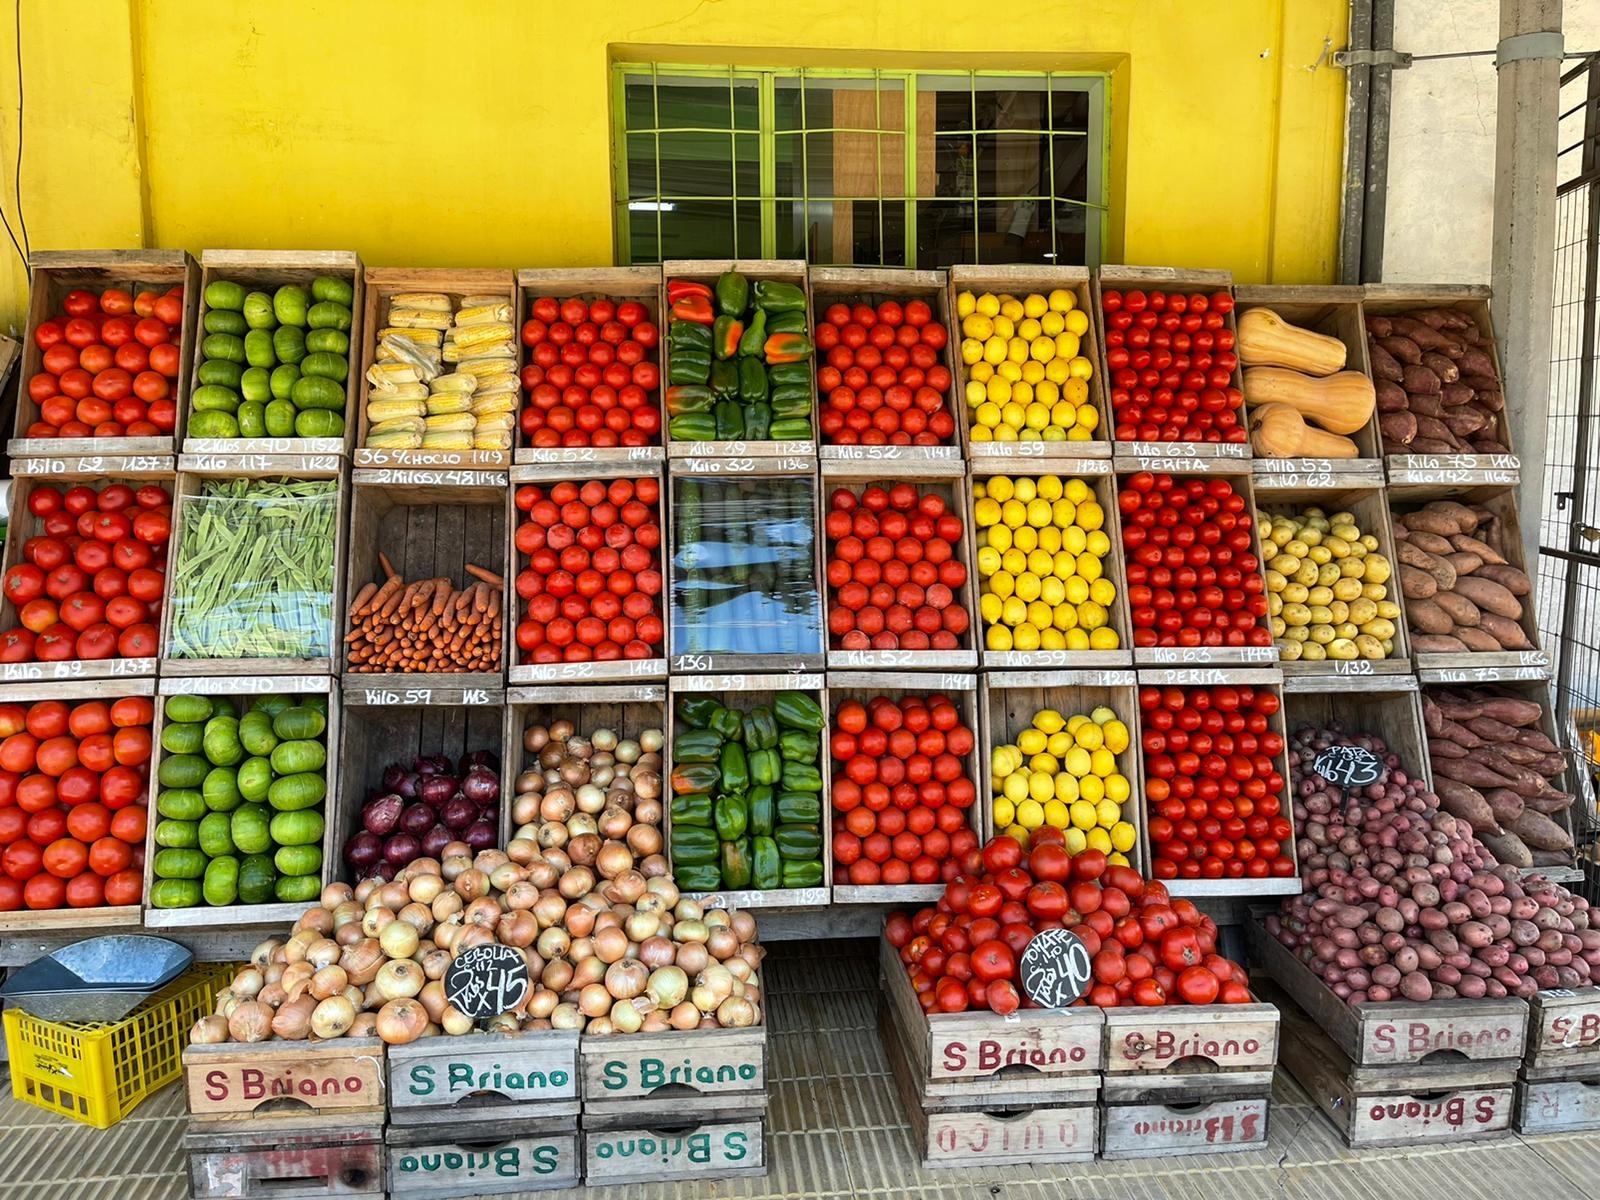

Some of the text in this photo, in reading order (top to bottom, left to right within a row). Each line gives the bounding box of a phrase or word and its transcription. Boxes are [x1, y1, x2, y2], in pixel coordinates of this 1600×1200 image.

[358, 448, 389, 464] 36
[866, 445, 901, 459] 52
[1018, 441, 1045, 456] 59
[1166, 442, 1196, 457] 63
[78, 456, 105, 473] 62
[724, 458, 755, 472] 32
[1138, 458, 1210, 472] PERITA
[1301, 458, 1332, 472] 53
[1306, 473, 1336, 487] 62
[879, 651, 916, 665] 52
[1034, 650, 1066, 666] 59
[1183, 647, 1211, 663] 63
[562, 663, 594, 678] 52
[1165, 669, 1230, 684] PERITA
[1471, 668, 1499, 681] 75
[721, 674, 745, 690] 39
[403, 689, 432, 704] 59
[1335, 759, 1378, 784] 43
[1055, 943, 1092, 997] 40
[486, 963, 528, 1016] 45
[1372, 1022, 1512, 1054] S Briano
[1551, 1016, 1572, 1044] S
[1122, 1029, 1260, 1061] S Briano
[943, 1040, 1087, 1071] S Briano
[408, 1064, 436, 1096] S
[602, 1058, 758, 1090] S Briano
[204, 1068, 363, 1101] S Briano
[1369, 1095, 1497, 1127] S Briano
[1239, 1113, 1261, 1142] S
[595, 1131, 749, 1164] S Briano
[399, 1146, 520, 1177] Briano
[532, 1144, 560, 1175] S
